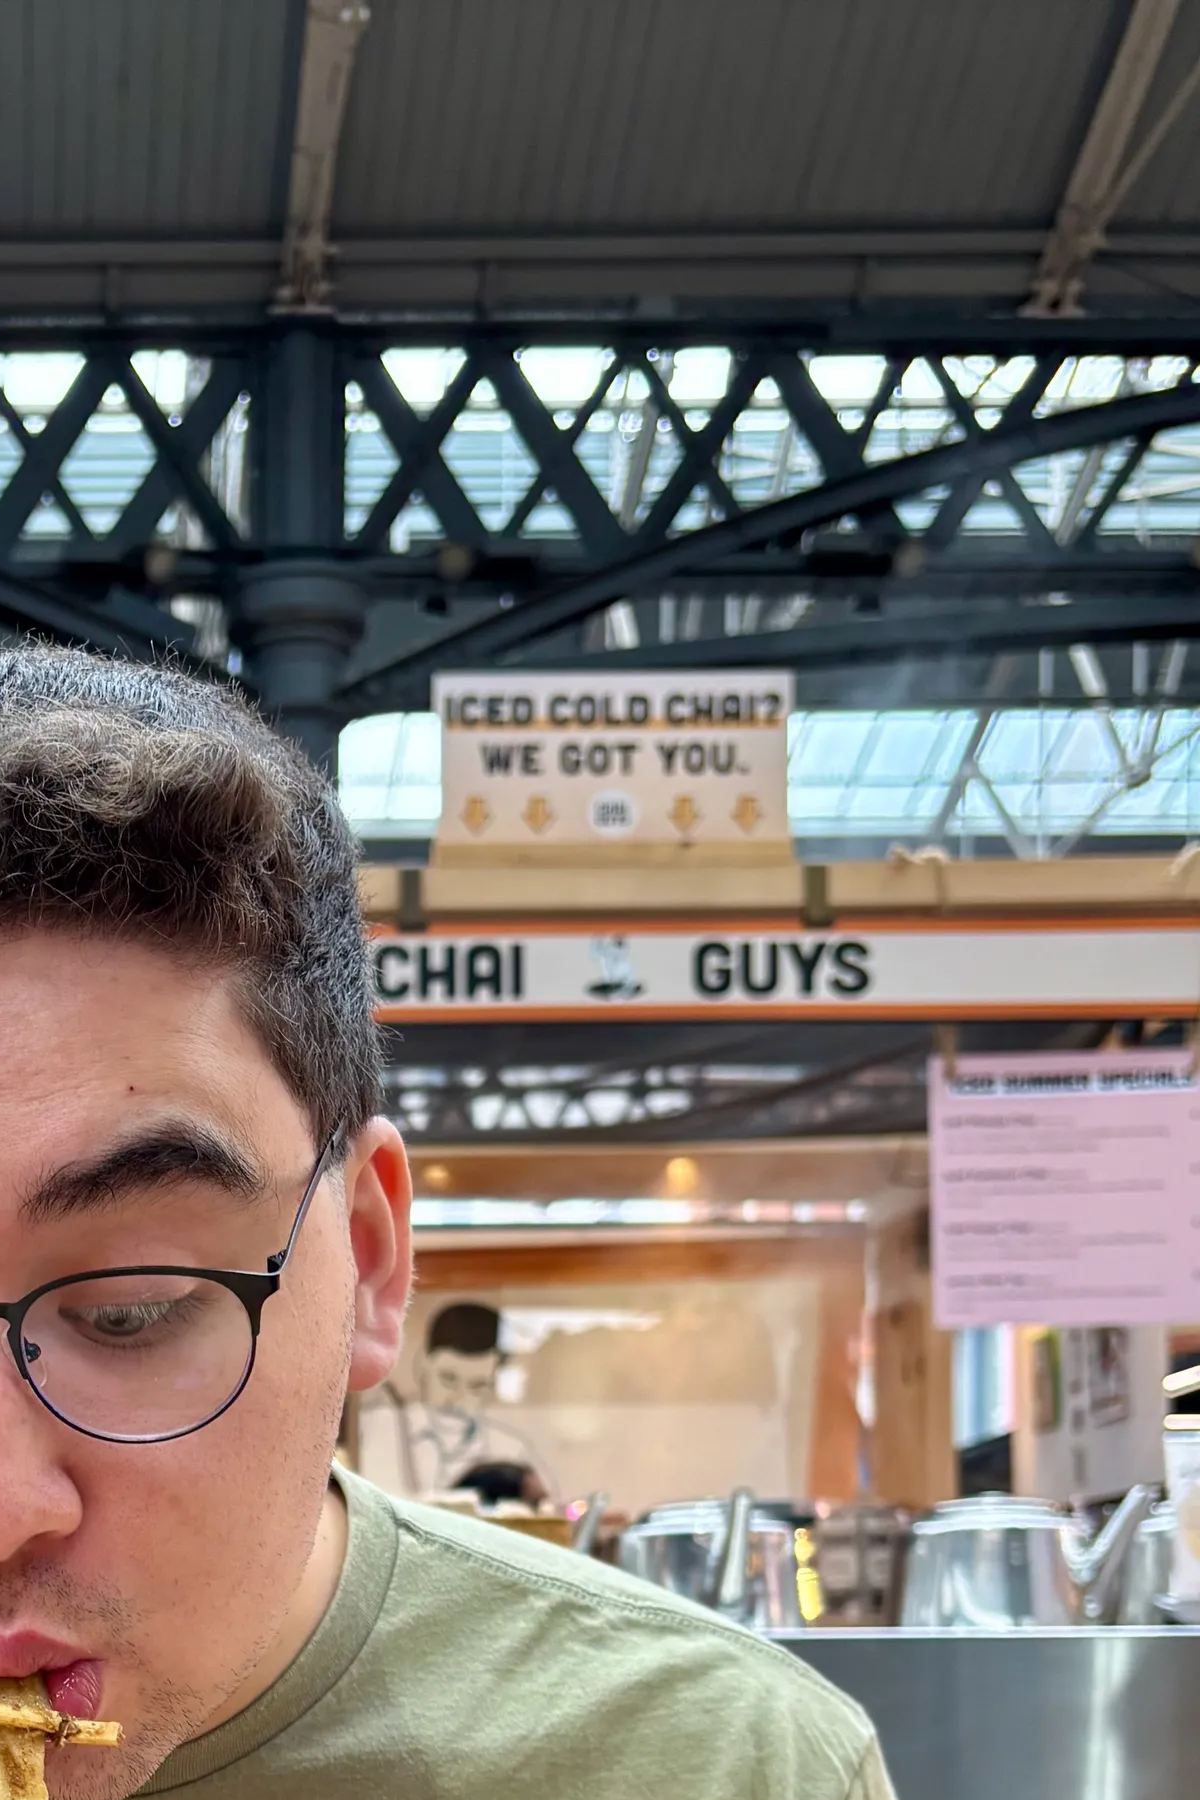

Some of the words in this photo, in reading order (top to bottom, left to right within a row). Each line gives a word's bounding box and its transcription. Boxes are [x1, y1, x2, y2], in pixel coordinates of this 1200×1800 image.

[445, 693, 534, 726] ICED
[549, 692, 650, 726] COLD
[665, 691, 782, 726] CHAI?
[480, 742, 544, 776] WE
[559, 742, 637, 776] GOT
[655, 742, 750, 776] YOU.
[376, 944, 523, 999] CHAI
[692, 941, 871, 998] GUYS
